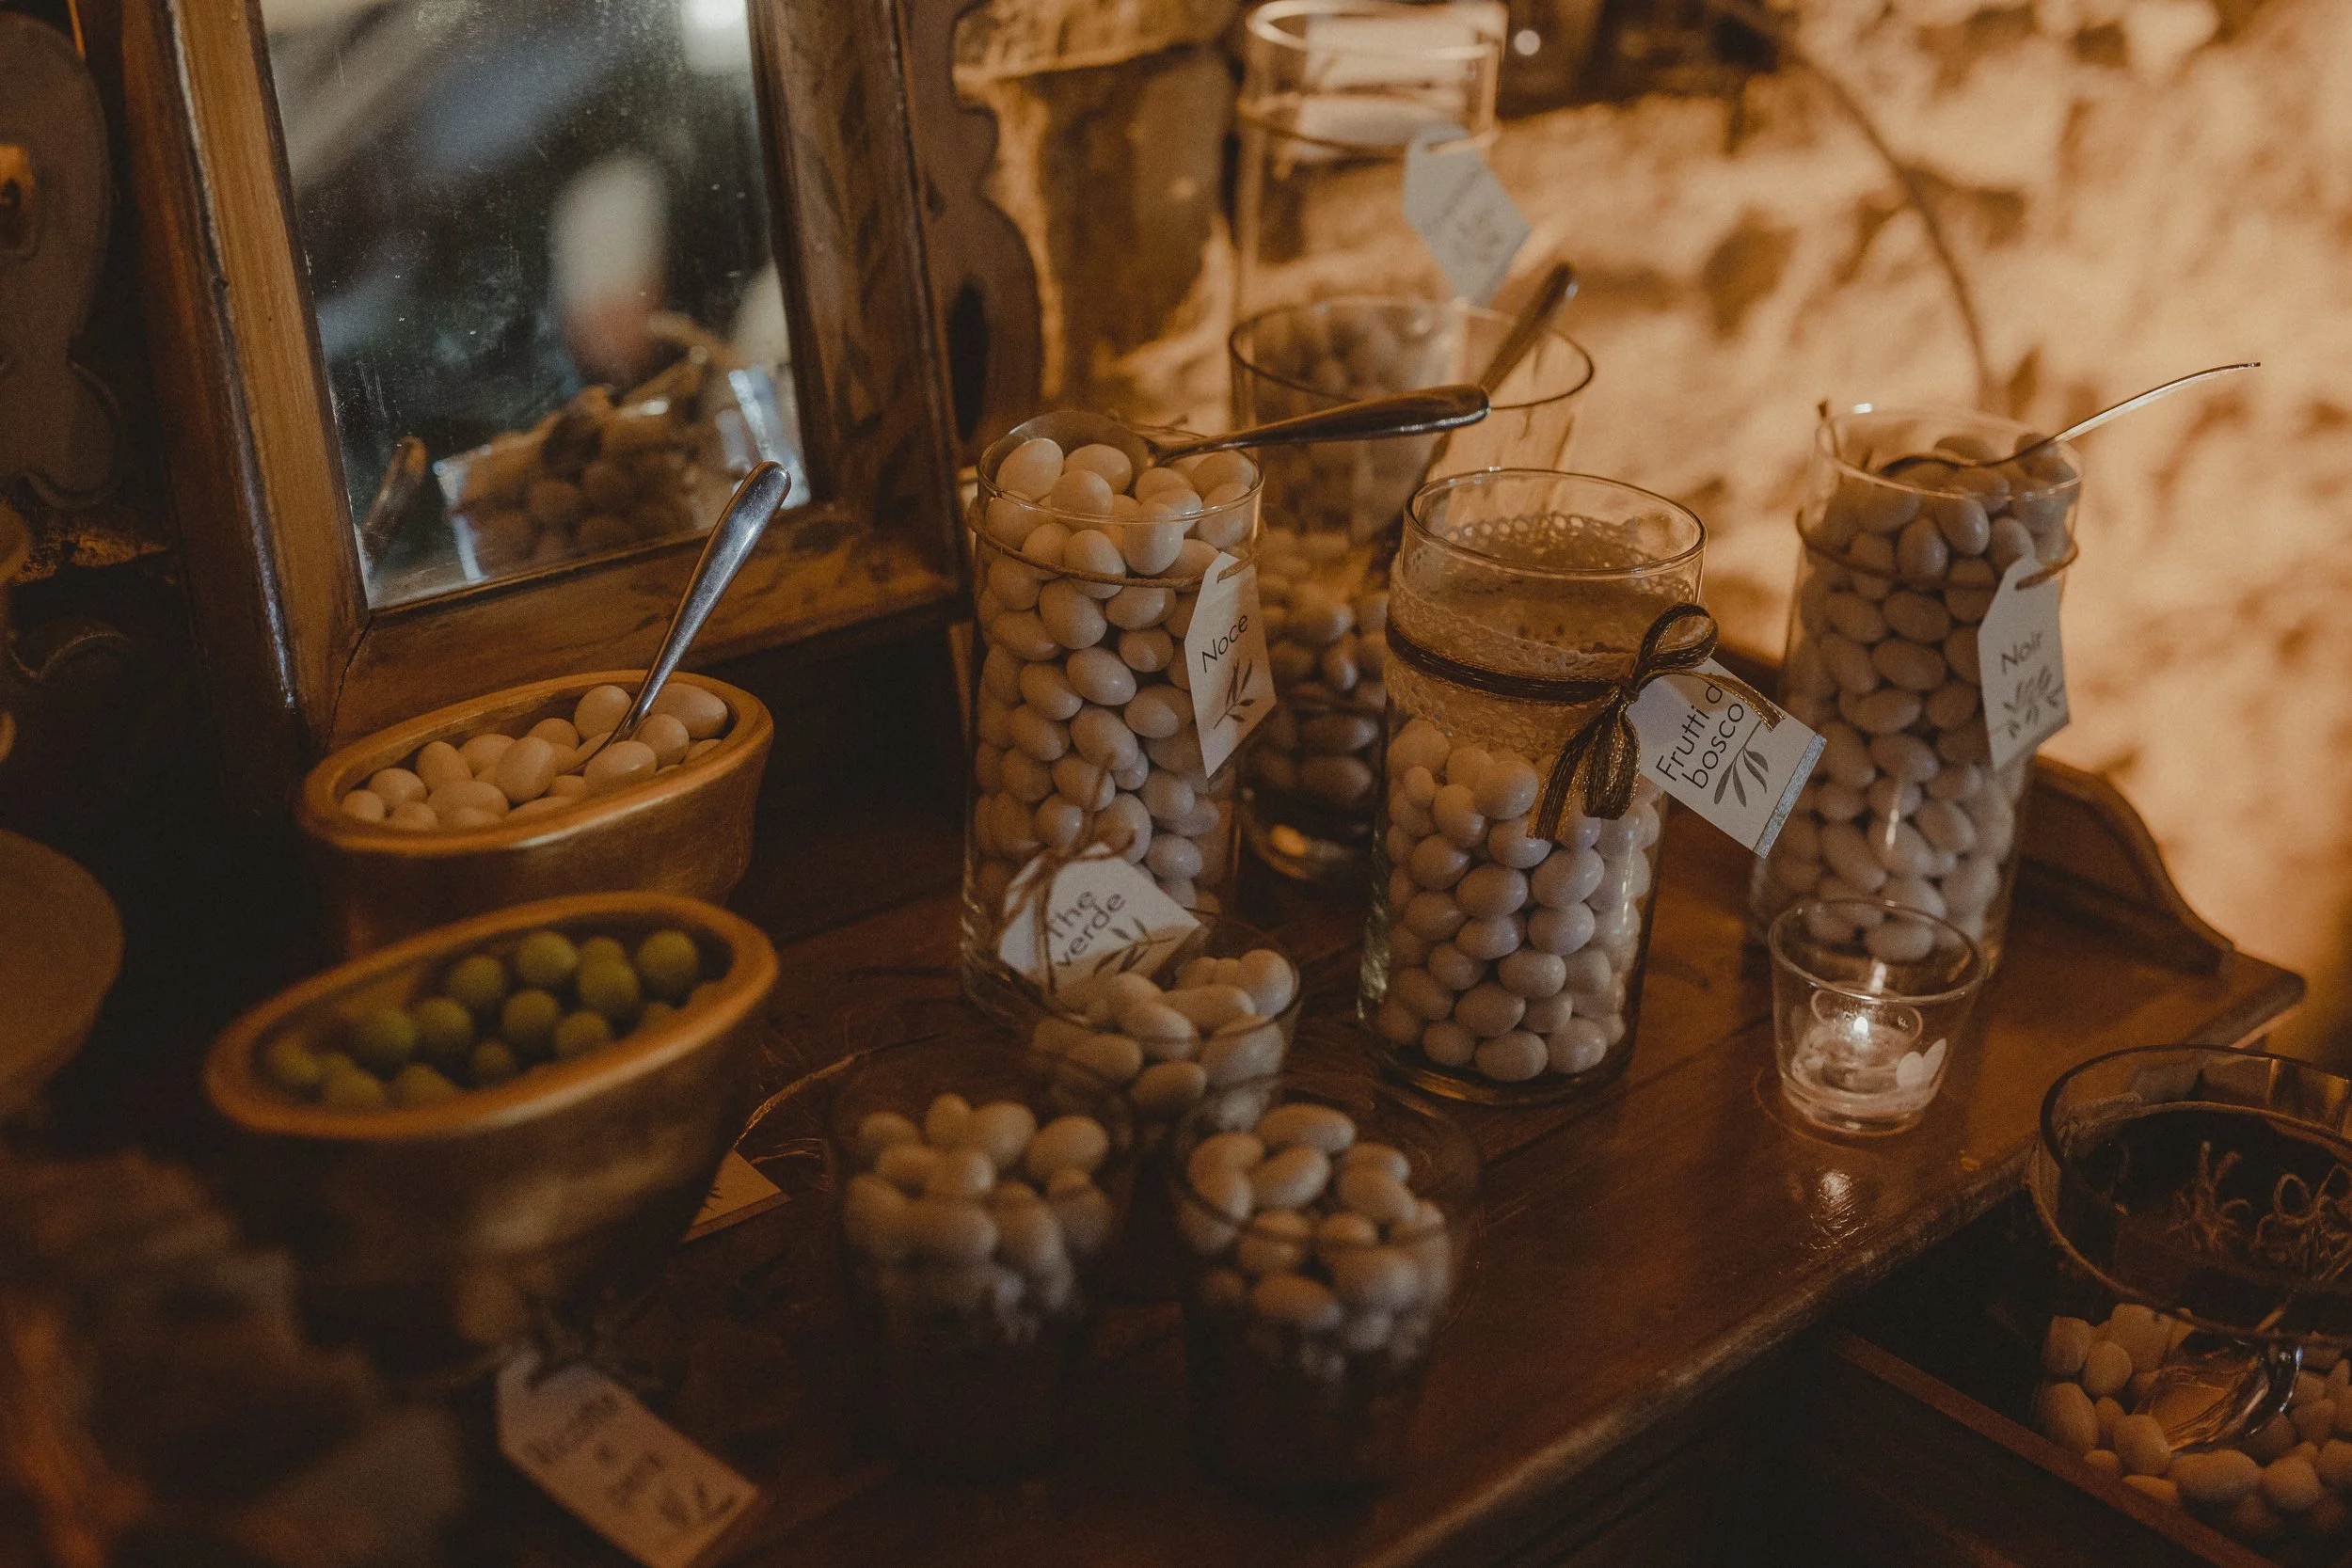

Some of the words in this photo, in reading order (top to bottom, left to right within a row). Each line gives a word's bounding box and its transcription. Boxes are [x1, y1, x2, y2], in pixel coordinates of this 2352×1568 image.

[1201, 615, 1248, 673] Noce
[1656, 705, 1710, 782] Frutti
[1681, 704, 1744, 789] bosco
[1055, 894, 1126, 966] verde
